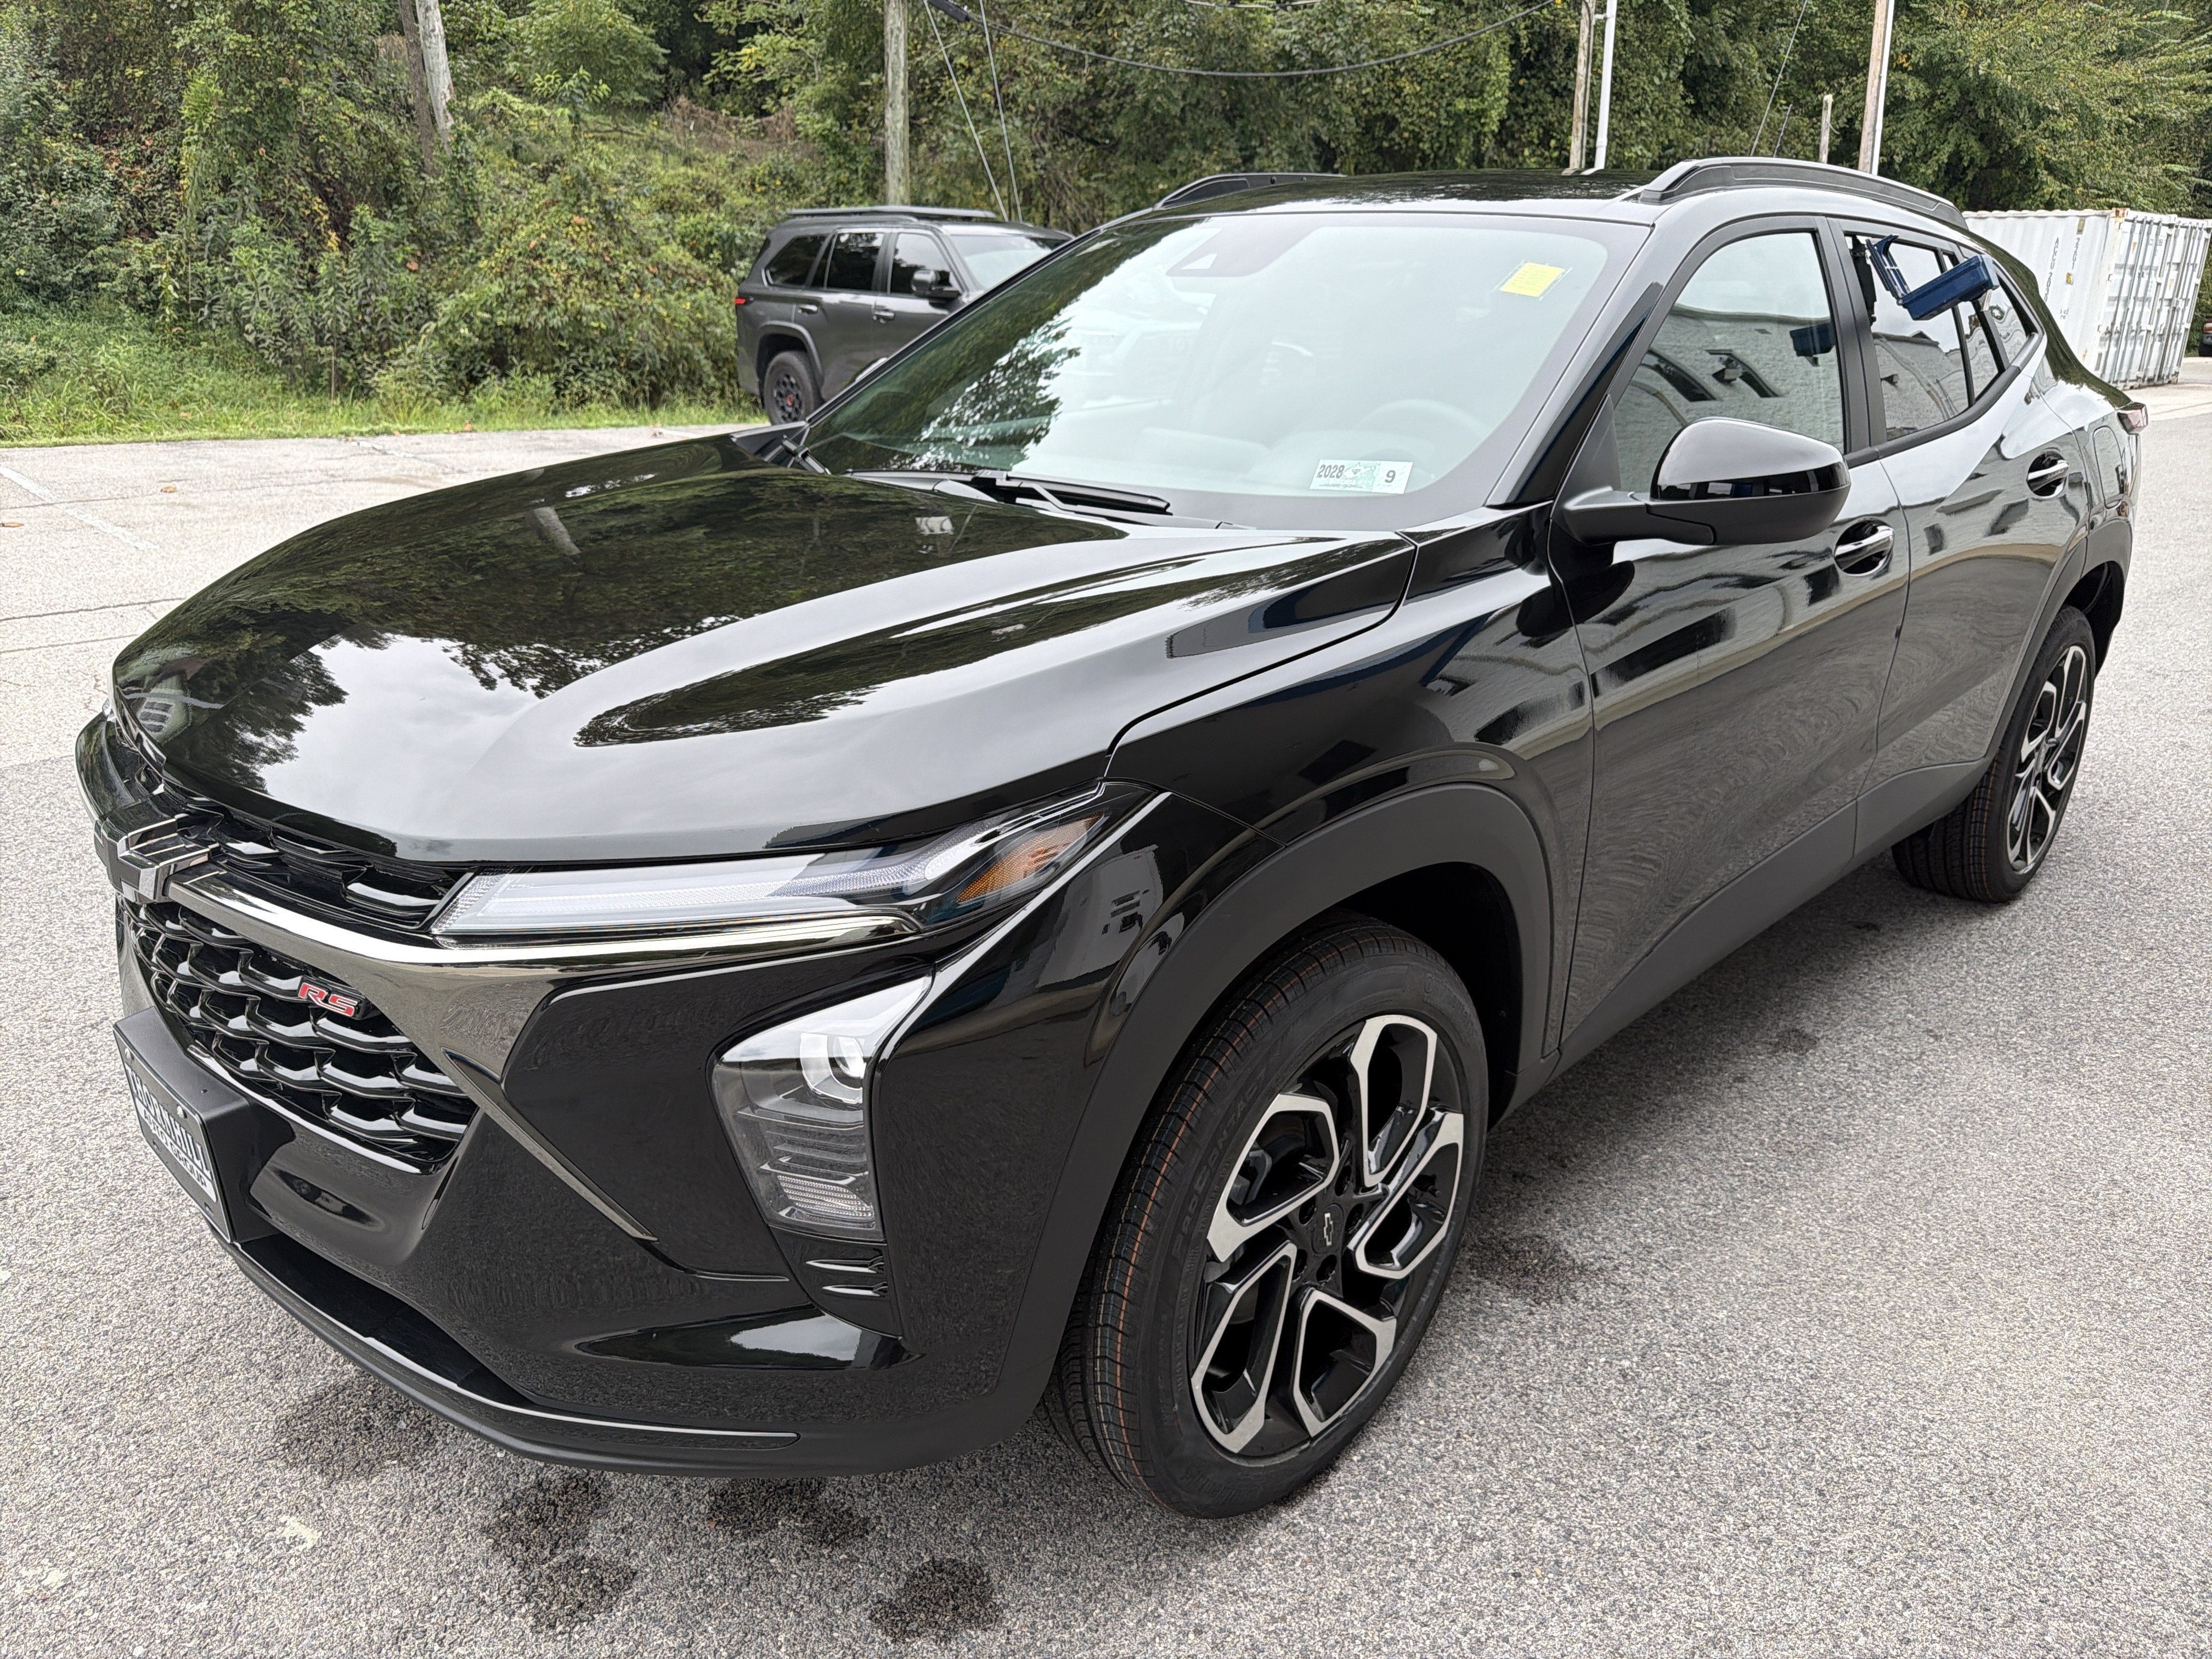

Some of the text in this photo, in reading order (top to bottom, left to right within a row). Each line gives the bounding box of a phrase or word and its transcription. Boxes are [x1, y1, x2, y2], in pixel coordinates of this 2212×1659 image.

[1316, 465, 1345, 478] 2028
[1385, 470, 1396, 483] 9
[298, 982, 358, 1017] RS
[125, 1062, 213, 1180] THORNHILL
[143, 1108, 207, 1188] AUTO GROUP
